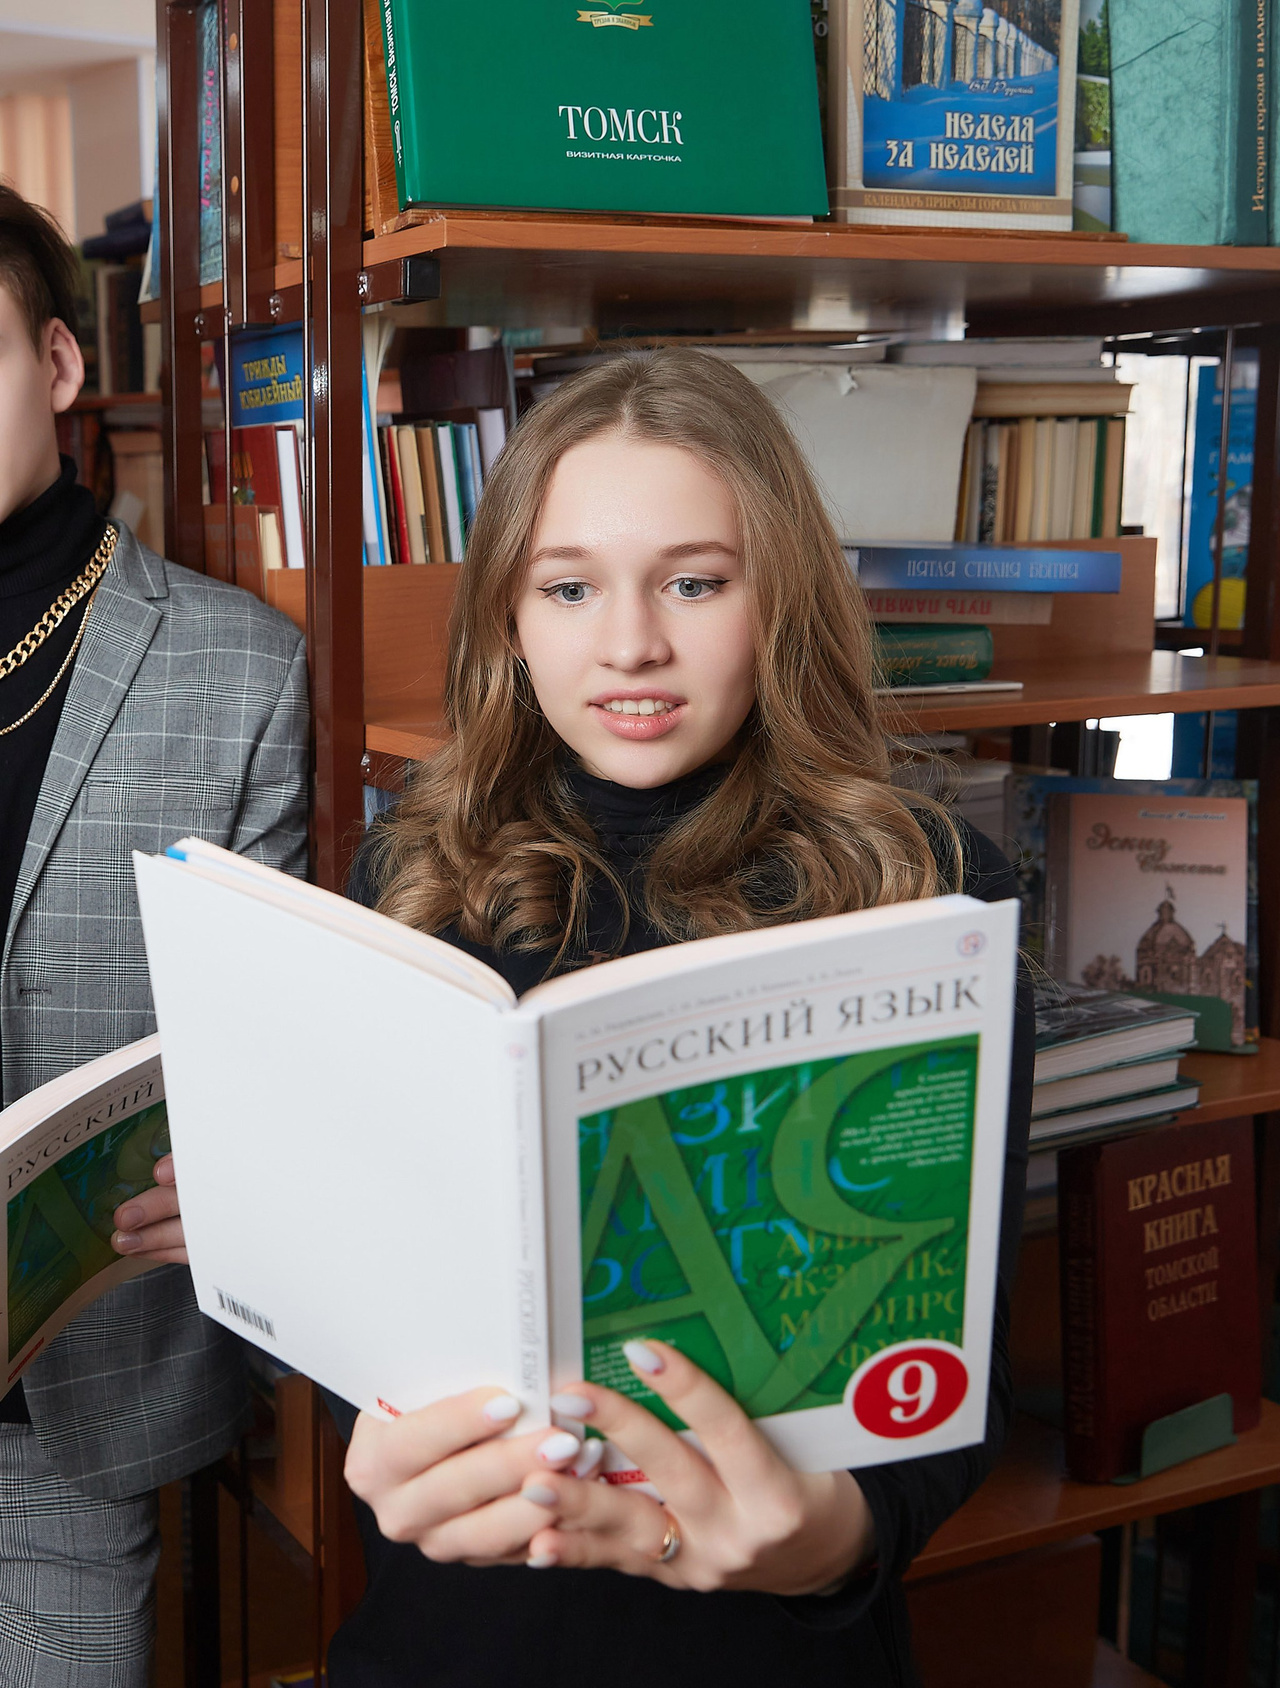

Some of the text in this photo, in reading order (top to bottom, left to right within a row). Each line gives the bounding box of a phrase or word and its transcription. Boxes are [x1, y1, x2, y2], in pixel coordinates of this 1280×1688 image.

[383, 7, 395, 65] Визитная
[388, 65, 399, 115] ТОМСК.
[1256, 74, 1267, 131] города
[558, 105, 684, 145] ТОМСК
[945, 111, 1034, 143] НЕДЕЛЯ
[566, 151, 682, 163] ВИЗИТНАЯ КАРТОЧКА
[886, 140, 1034, 174] ЗА НЕДЕЛЕЙ
[1252, 136, 1267, 212] История
[864, 194, 922, 207] КАЛЕНДАРЬ
[242, 354, 287, 382] ТРИЖДЫ
[239, 374, 303, 410] ЮБИЛЕЙНЫЙ
[906, 559, 956, 578] ПЯТАЯ
[964, 560, 1021, 579] СТИХИЯ
[946, 599, 992, 616] ПУТЬ
[576, 999, 815, 1093] РУССКИЙ
[837, 975, 982, 1032] ЯЗЫК
[8, 1081, 154, 1190] РУССКИЙ
[1127, 1154, 1232, 1212] КРАСНАЯ
[1143, 1204, 1219, 1253] КНИГА
[1145, 1246, 1219, 1290] ТОМСКОЙ
[1147, 1279, 1218, 1322] ОБЛАСТИ
[887, 1360, 938, 1425] 9
